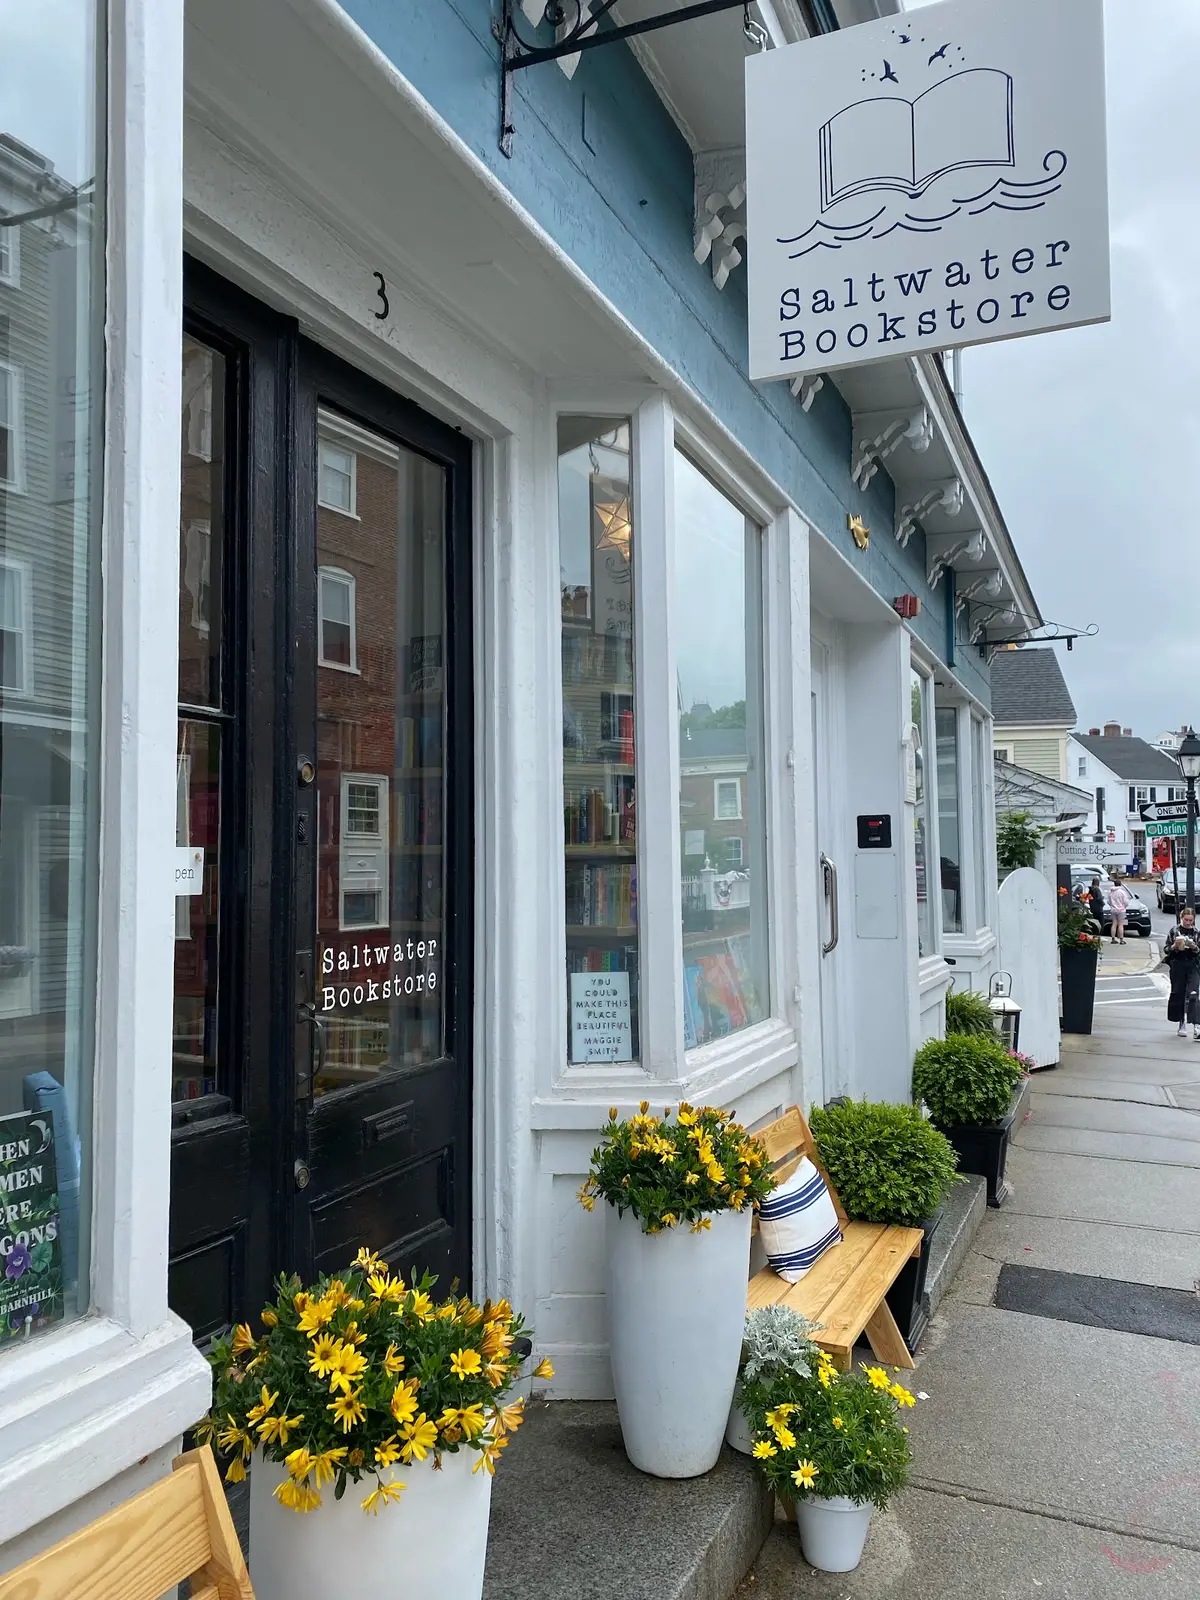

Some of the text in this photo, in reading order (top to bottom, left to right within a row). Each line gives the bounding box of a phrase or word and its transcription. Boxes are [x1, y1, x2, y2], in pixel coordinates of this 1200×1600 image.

[779, 240, 1071, 322] Saltwater
[373, 271, 389, 319] 3
[779, 284, 1071, 361] Bookstore
[1157, 805, 1188, 815] ONE WA
[1157, 823, 1187, 835] Darling
[1059, 845, 1087, 856] Cutting
[175, 868, 195, 882] pen
[322, 938, 437, 974] Saltwater
[591, 978, 611, 986] YOU
[321, 972, 437, 1011] Bookstore
[585, 989, 618, 997] COULD
[576, 1000, 628, 1008] MAKE THIS
[587, 1010, 617, 1019] PLACE
[577, 1022, 629, 1031] BEAUTIFUL
[584, 1036, 622, 1045] MAGGIE
[588, 1047, 619, 1056] SMITH
[0, 1139, 30, 1161] HEN
[0, 1166, 43, 1194] MEN
[0, 1199, 32, 1225] ERE
[0, 1221, 57, 1256] GONS
[0, 1287, 55, 1316] BARNHILL
